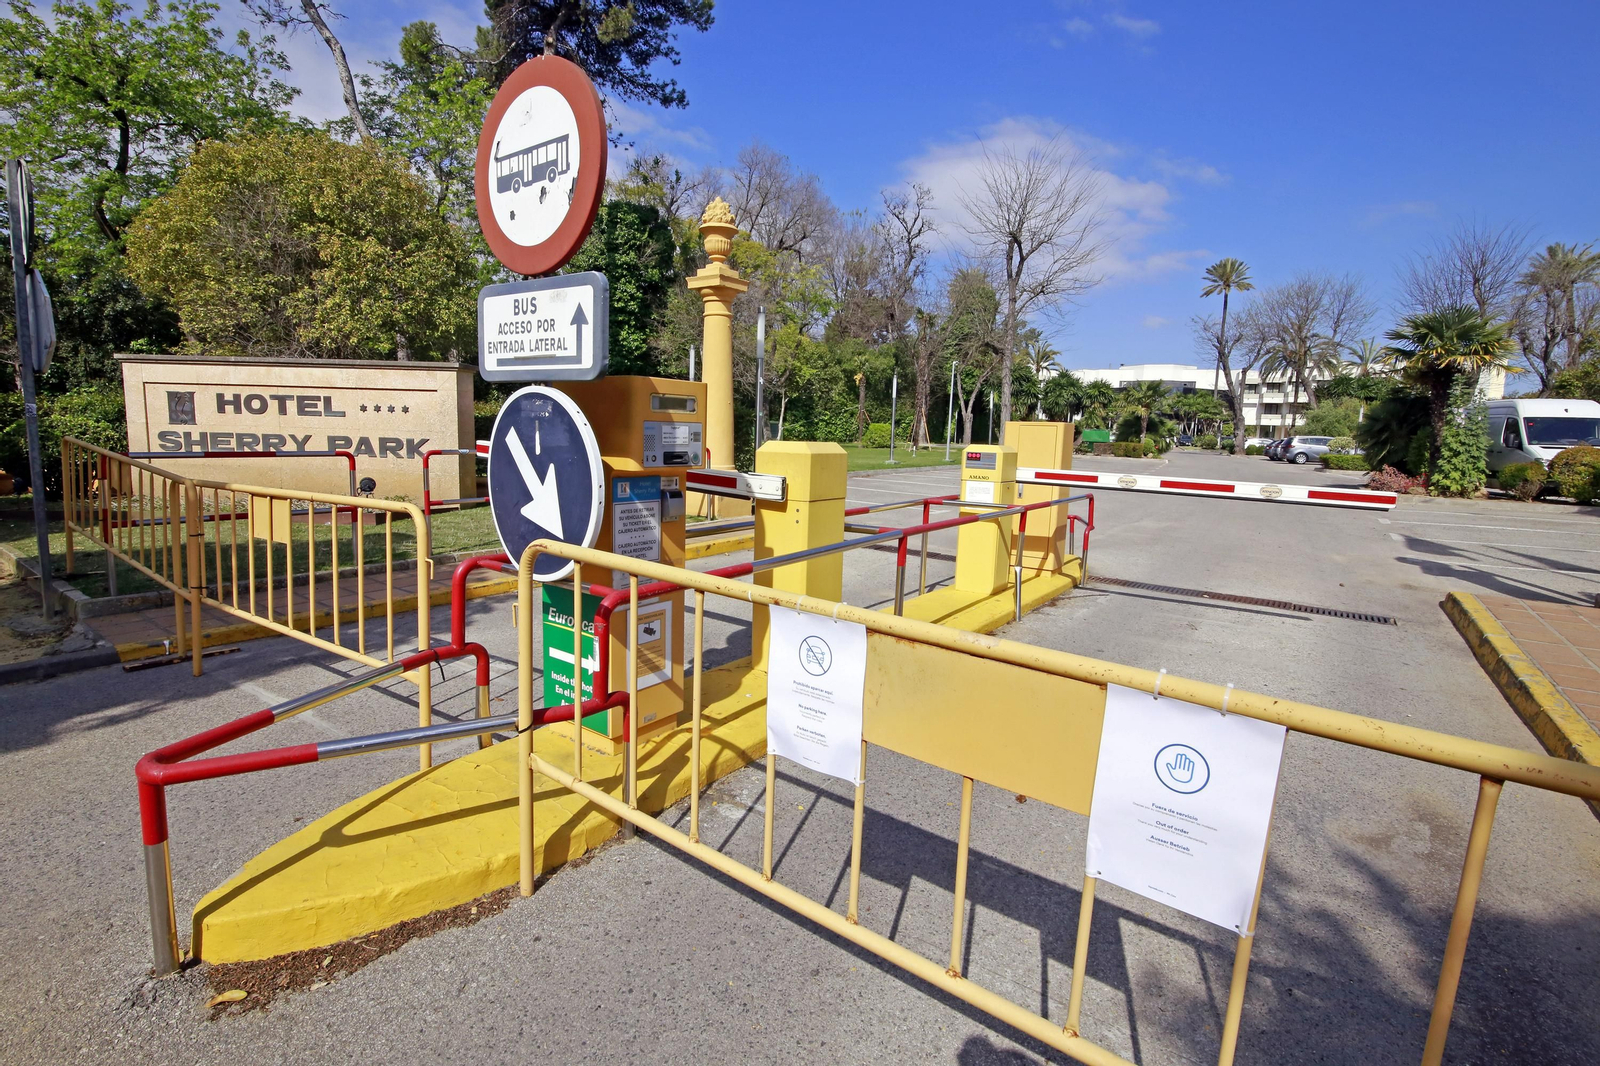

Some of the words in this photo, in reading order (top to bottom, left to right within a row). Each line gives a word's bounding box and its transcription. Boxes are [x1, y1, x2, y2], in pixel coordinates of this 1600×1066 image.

[513, 296, 538, 316] BUS
[498, 320, 532, 336] ACCESO
[536, 318, 556, 333] POR
[488, 340, 525, 354] ENTRADA
[529, 337, 568, 352] LATERAL
[216, 392, 346, 418] HOTEL
[157, 430, 313, 452] SHERRY
[327, 434, 430, 460] PARK
[548, 606, 594, 633] Euroca
[551, 670, 569, 684] Inside
[555, 684, 563, 694] En
[564, 688, 570, 697] el
[804, 706, 818, 714] parking
[1151, 802, 1167, 811] Fuera
[1176, 811, 1198, 821] servicio
[1174, 826, 1189, 834] order
[1150, 835, 1169, 844] Ausser
[1169, 841, 1190, 852] Betrieb
